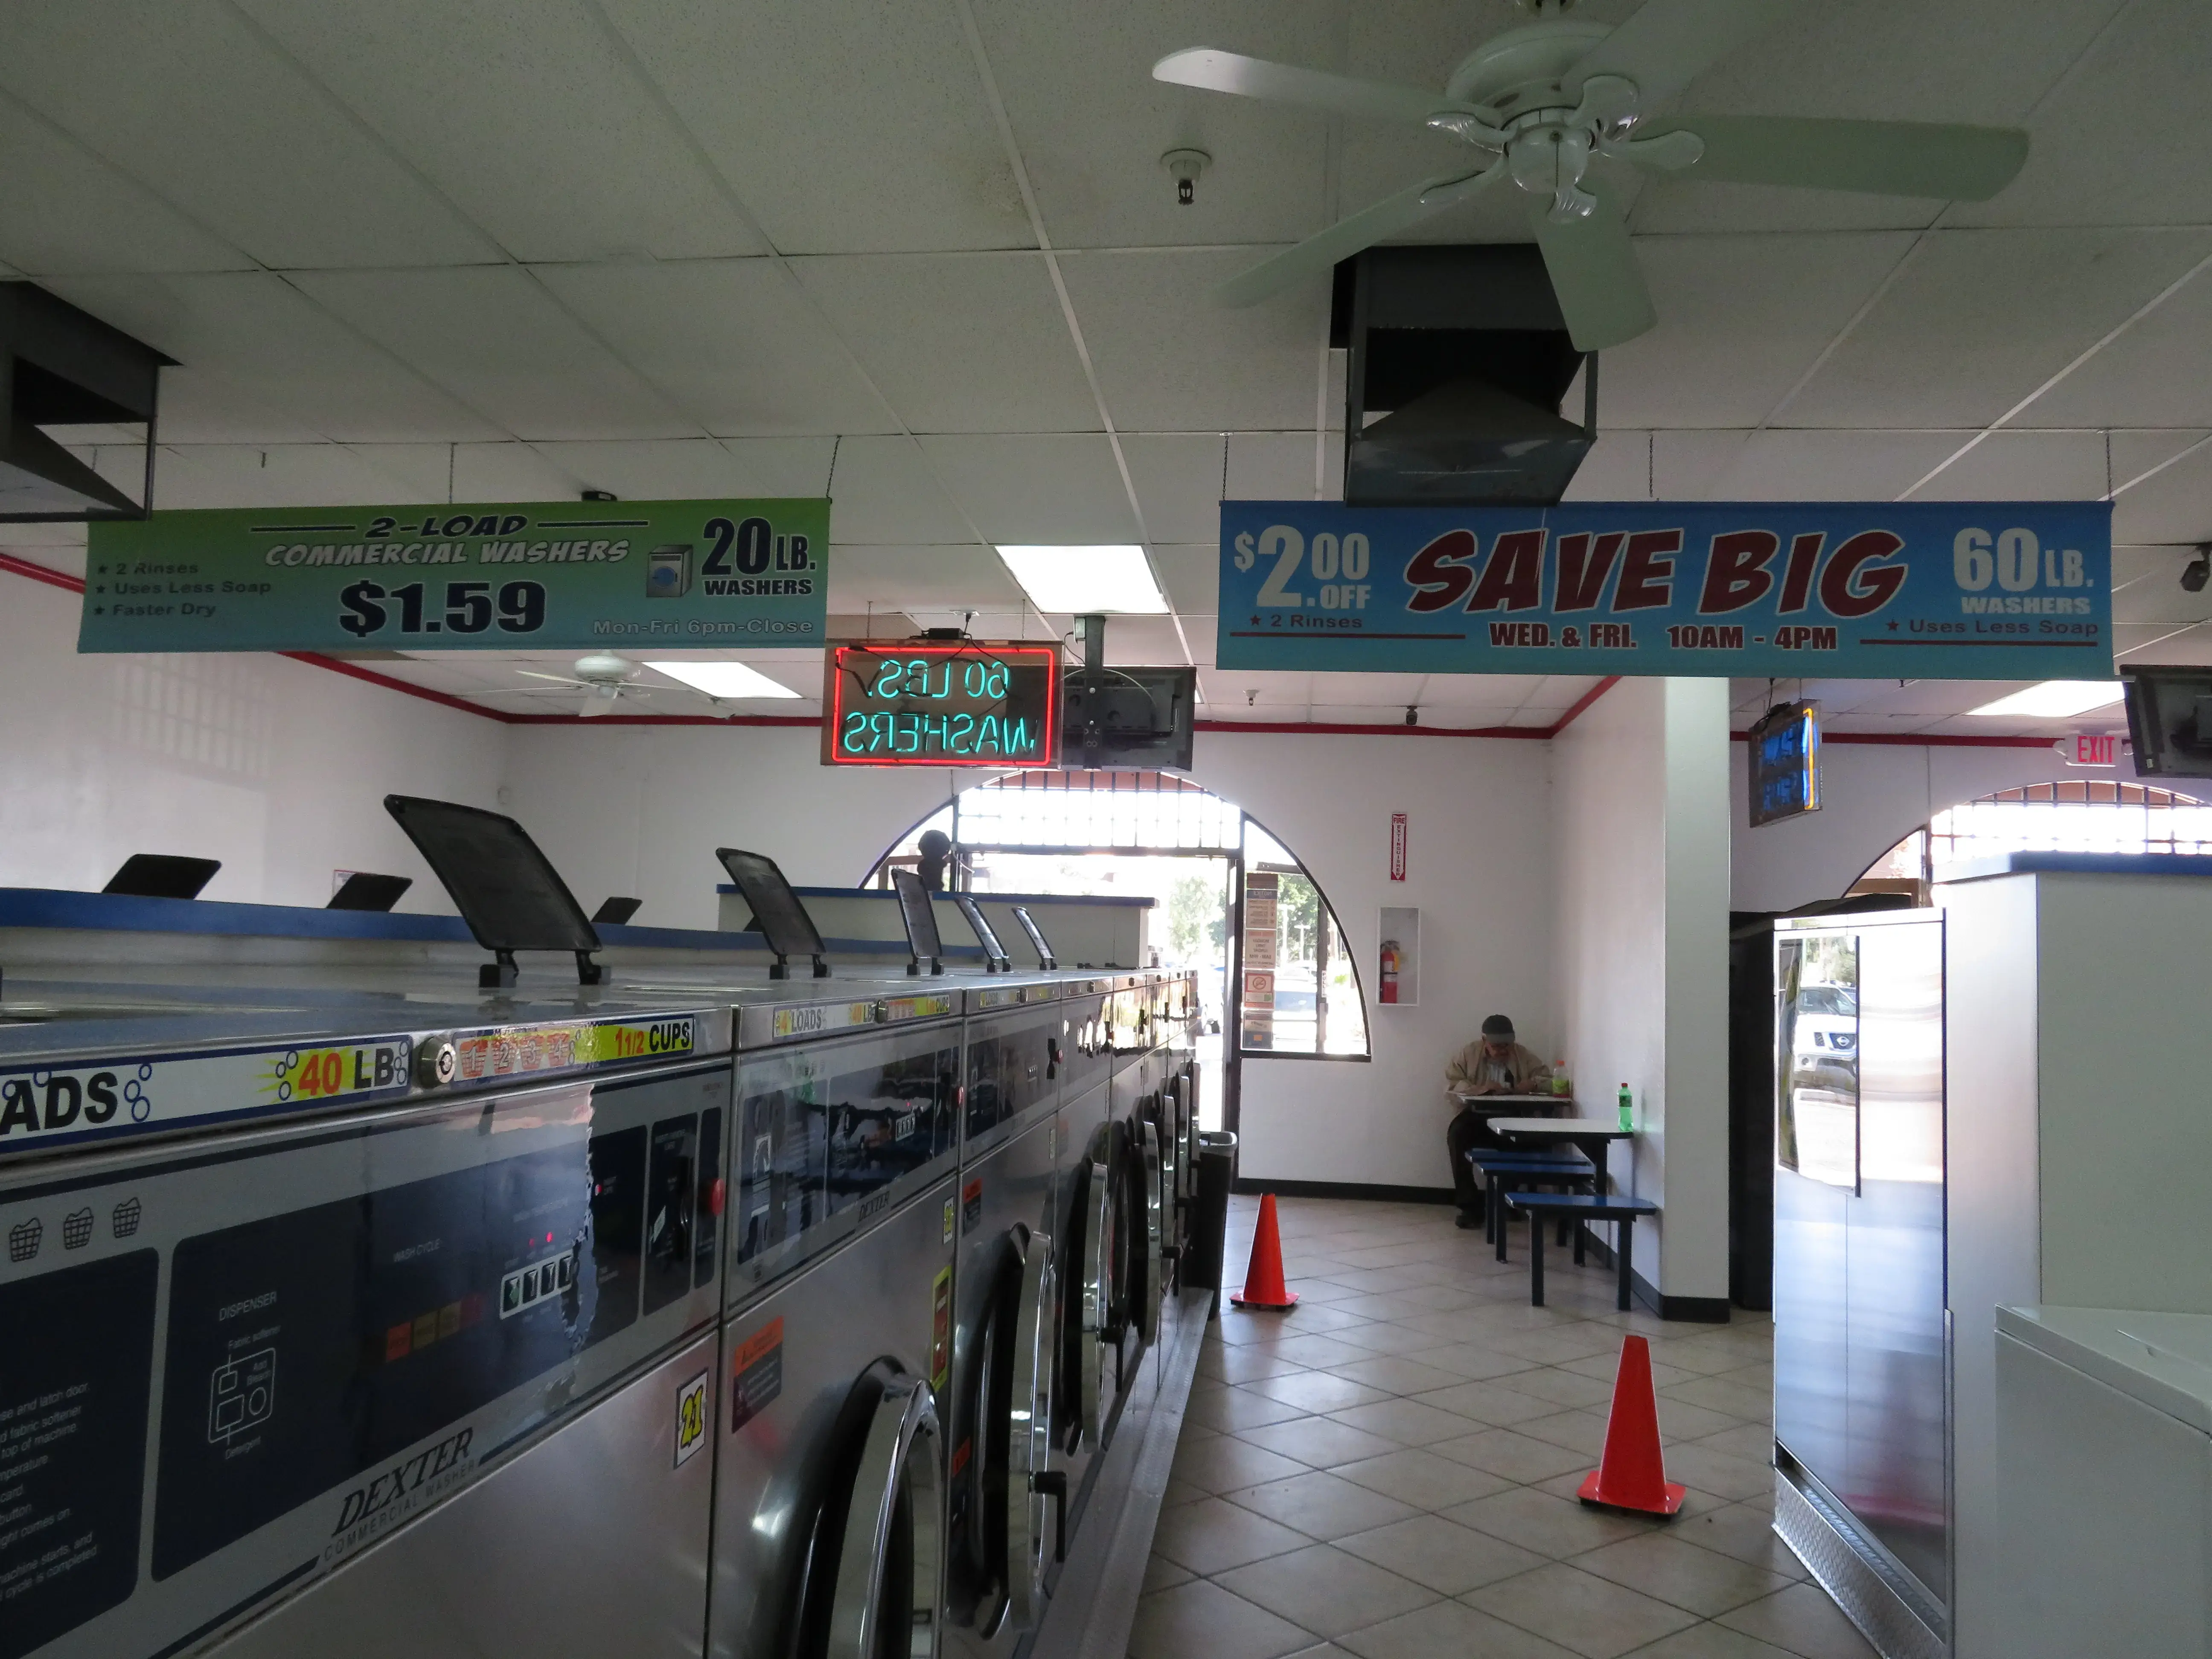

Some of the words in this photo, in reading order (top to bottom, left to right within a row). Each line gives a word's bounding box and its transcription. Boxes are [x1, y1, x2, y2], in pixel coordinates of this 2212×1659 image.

[365, 515, 527, 538] 2-LOAD
[265, 541, 467, 567] COMMERCIAL
[479, 540, 630, 564] WASHERS
[701, 517, 772, 576] 20
[775, 533, 817, 572] LB.
[1953, 527, 2039, 591] 60
[2045, 549, 2094, 588] LB.
[116, 564, 126, 574] 2
[134, 562, 199, 574] Rinses
[1403, 527, 1684, 615] SAVE
[1696, 529, 1908, 619] BIG
[115, 583, 162, 594] Uses
[169, 581, 214, 594] Less
[222, 580, 271, 595] Soap
[704, 578, 812, 596] WASHERS
[113, 604, 174, 616] Faster
[181, 602, 216, 617] Dry
[340, 579, 546, 637] $1.59
[1962, 597, 2091, 614] WASHERS
[594, 620, 680, 634] Mon-Fri
[687, 619, 813, 637] 6pm-Close
[1270, 615, 1282, 627] 2
[1290, 614, 1363, 628] Rinses
[1909, 620, 1966, 634] Uses
[1976, 620, 2030, 634] Less
[2039, 620, 2098, 637] Soap
[1489, 621, 1556, 648] WED.
[1562, 626, 1580, 649] &
[1588, 623, 1638, 649] FRI.
[1666, 625, 1744, 649] 10AM
[1774, 625, 1838, 651] 4PM
[2077, 736, 2116, 763] EXIT
[792, 1008, 822, 1033] LOADS
[649, 1022, 690, 1052] CUPS
[466, 1044, 477, 1071] 1
[499, 1041, 511, 1068] 2
[298, 1052, 343, 1096] 40
[354, 1048, 394, 1089] LB
[0, 1071, 118, 1135] ADS
[219, 1291, 277, 1321] DISPENSER
[17, 1398, 37, 1415] and
[40, 1391, 64, 1407] latch
[681, 1384, 703, 1449] 21
[10, 1420, 39, 1439] fabric
[42, 1405, 82, 1428] softener
[21, 1436, 32, 1452] of
[331, 1426, 473, 1538] DEXTER
[325, 1494, 418, 1562] COMMERCIAL
[426, 1459, 474, 1499] WASHER
[21, 1515, 55, 1537] comes
[74, 1531, 93, 1549] and
[6, 1578, 33, 1599] cycle
